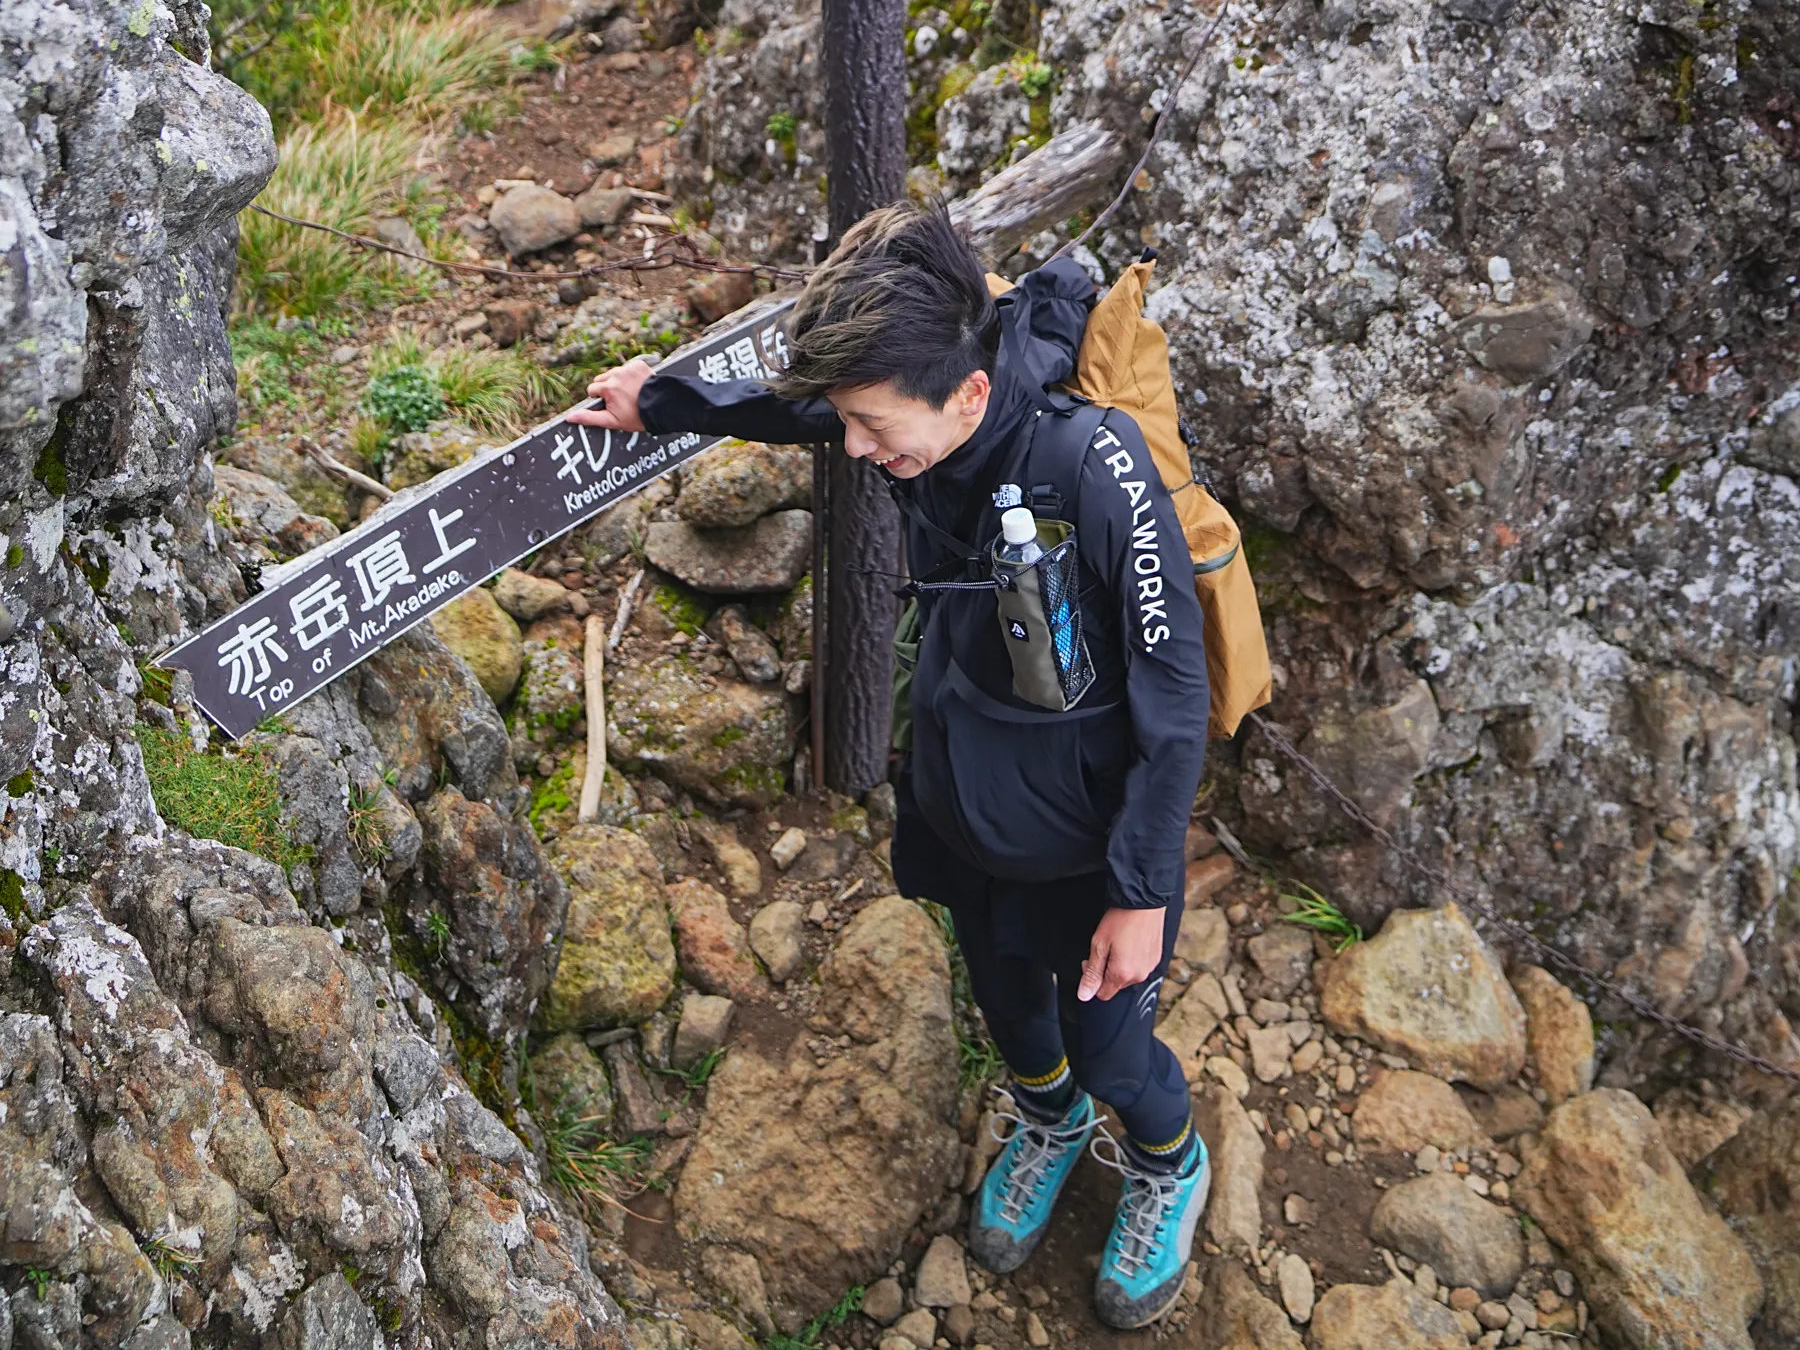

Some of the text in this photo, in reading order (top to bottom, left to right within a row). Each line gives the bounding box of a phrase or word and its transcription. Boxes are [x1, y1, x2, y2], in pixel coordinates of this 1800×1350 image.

[217, 508, 478, 695] 赤岳頂上
[1093, 425, 1171, 653] TRALWORKS.
[249, 569, 461, 711] Top of Mt.Akadake
